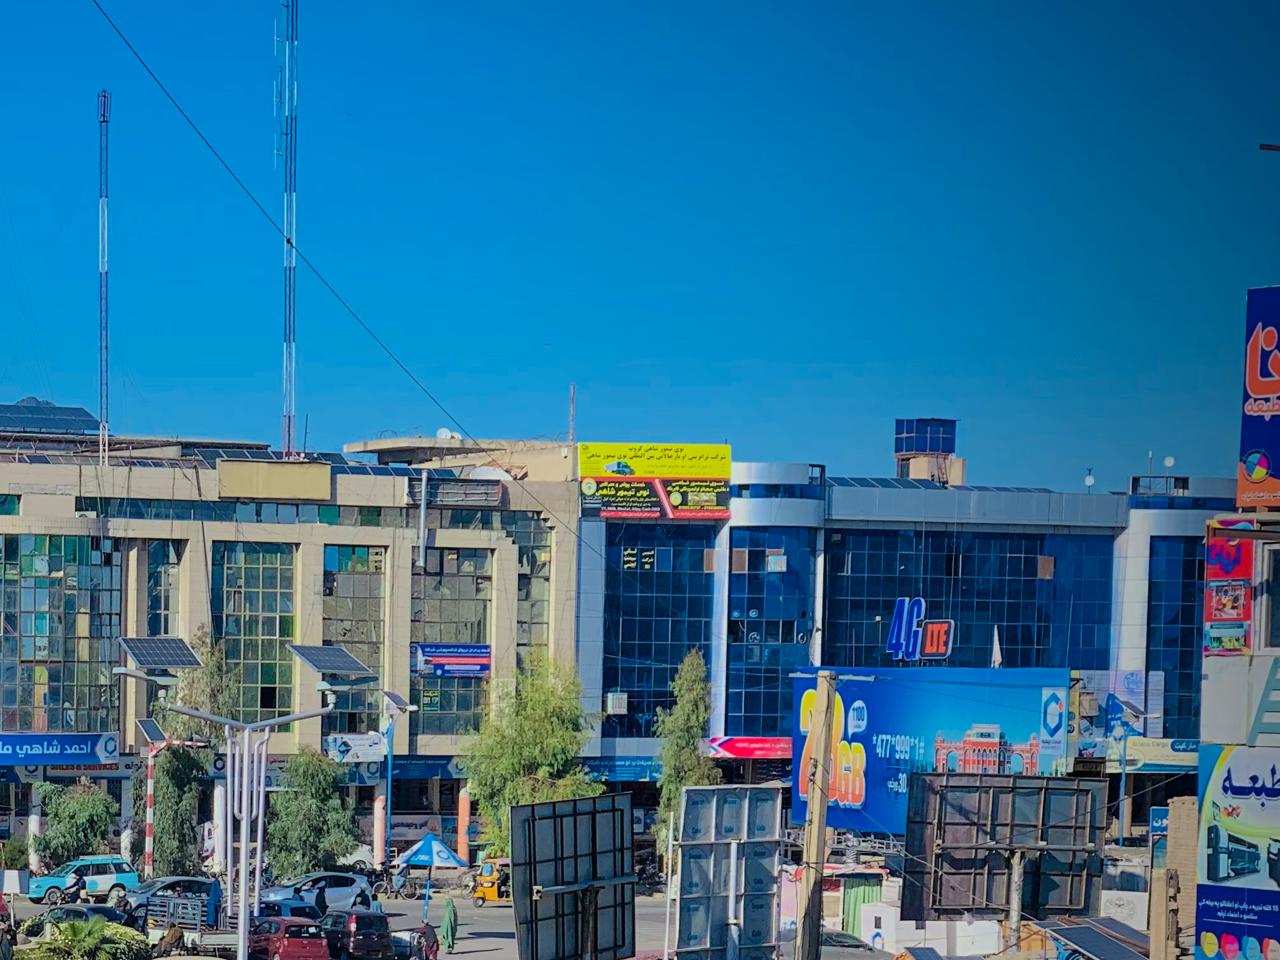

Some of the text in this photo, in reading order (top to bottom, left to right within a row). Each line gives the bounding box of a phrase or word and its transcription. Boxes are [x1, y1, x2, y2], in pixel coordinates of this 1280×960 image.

[886, 597, 949, 661] 4G LTE
[63, 742, 91, 754] احمد
